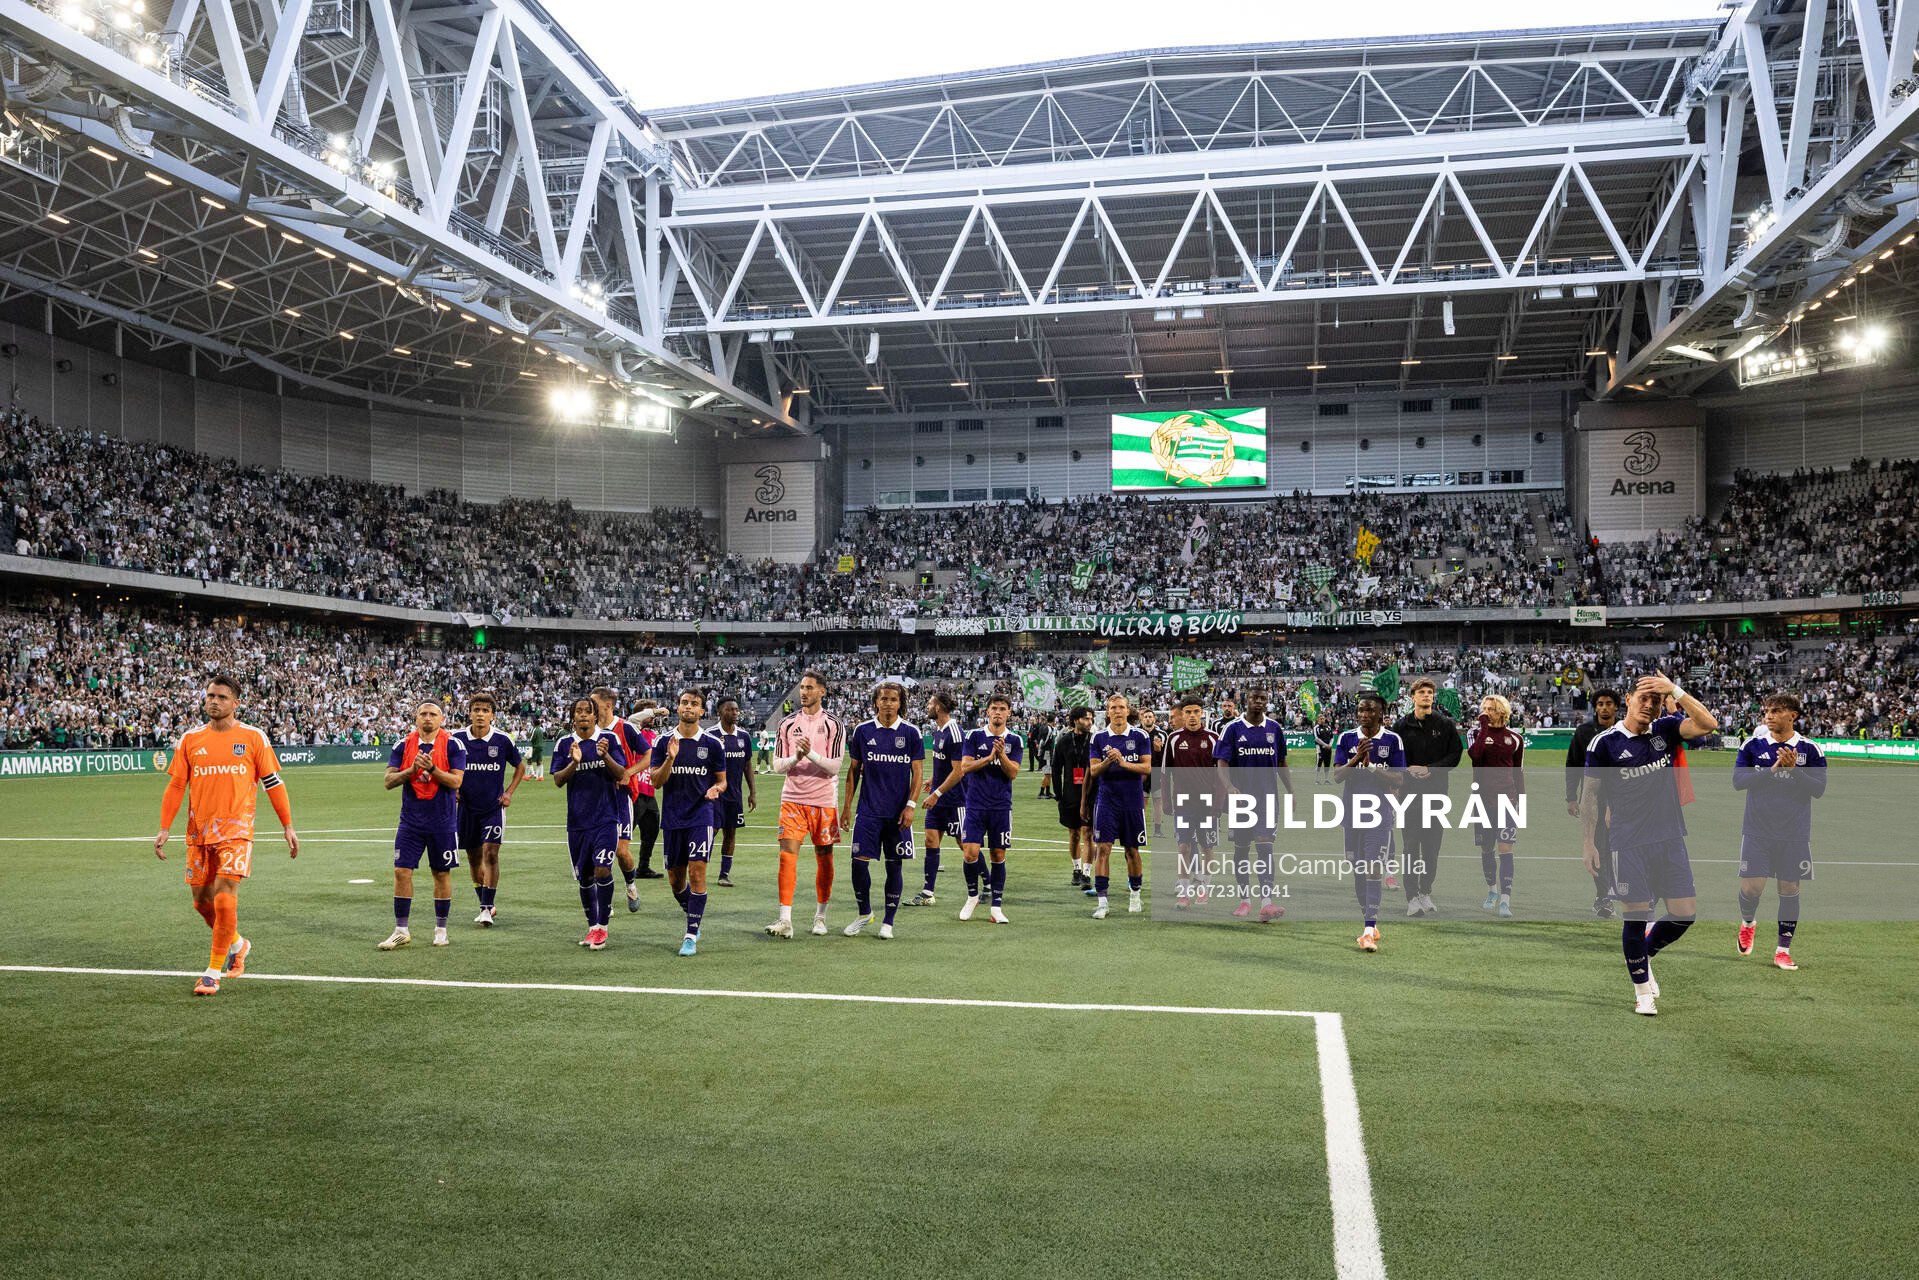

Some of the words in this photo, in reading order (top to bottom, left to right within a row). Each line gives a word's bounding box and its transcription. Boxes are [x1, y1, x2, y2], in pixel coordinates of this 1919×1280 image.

[1610, 479, 1675, 496] Arena
[744, 507, 797, 523] Arena
[1028, 616, 1096, 630] ULTRAS
[1100, 615, 1167, 637] ULTRA
[1186, 614, 1241, 635] BOYS
[280, 752, 308, 763] CRAFT
[352, 750, 376, 760] CRAFT
[725, 750, 746, 758] nweb
[867, 751, 911, 764] Sunweb
[1238, 746, 1275, 756] Sunweb
[1, 756, 83, 775] AMMARBY
[86, 753, 146, 772] FOTBOLL
[194, 763, 247, 777] Sunweb
[465, 762, 501, 772] unweb
[575, 760, 606, 772] unwe
[671, 766, 707, 776] unweb
[484, 826, 503, 840] 79
[947, 822, 960, 835] 27
[1500, 827, 1517, 841] 62
[1000, 831, 1011, 846] 18
[1137, 830, 1146, 844] 6
[688, 841, 708, 857] 24
[896, 841, 913, 856] 68
[222, 851, 245, 872] 26
[443, 850, 459, 866] 91
[596, 848, 615, 865] 49
[1800, 860, 1812, 877] 9
